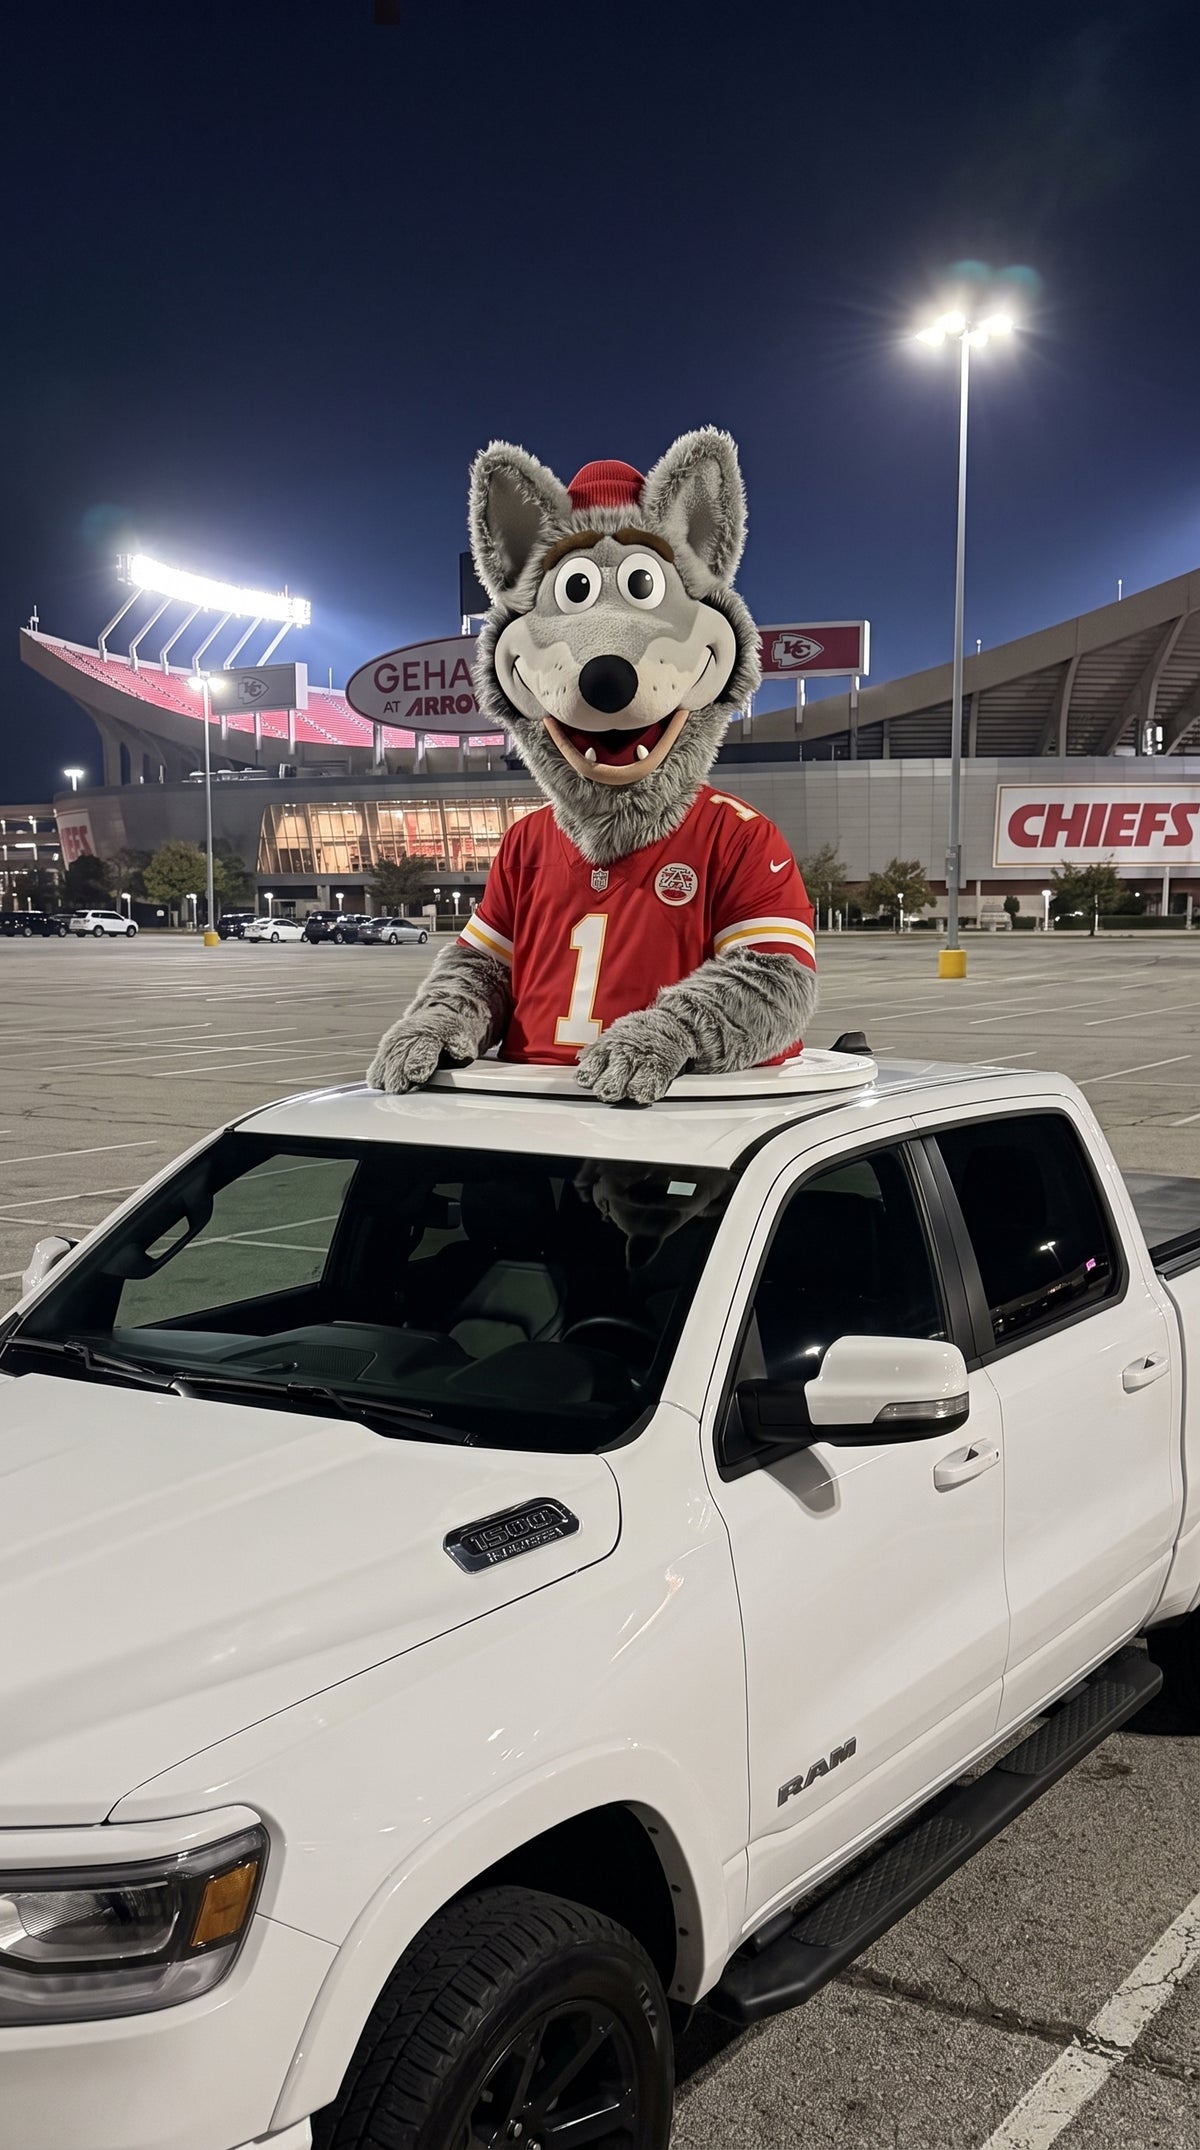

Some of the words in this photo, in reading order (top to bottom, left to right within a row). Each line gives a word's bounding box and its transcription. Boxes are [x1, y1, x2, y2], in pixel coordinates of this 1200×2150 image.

[373, 658, 474, 694] GEHA
[383, 700, 401, 714] AT
[1008, 803, 1200, 848] CHIEFS
[554, 913, 609, 1047] 1
[470, 1510, 553, 1551] 1500
[777, 1736, 856, 1808] RAM
